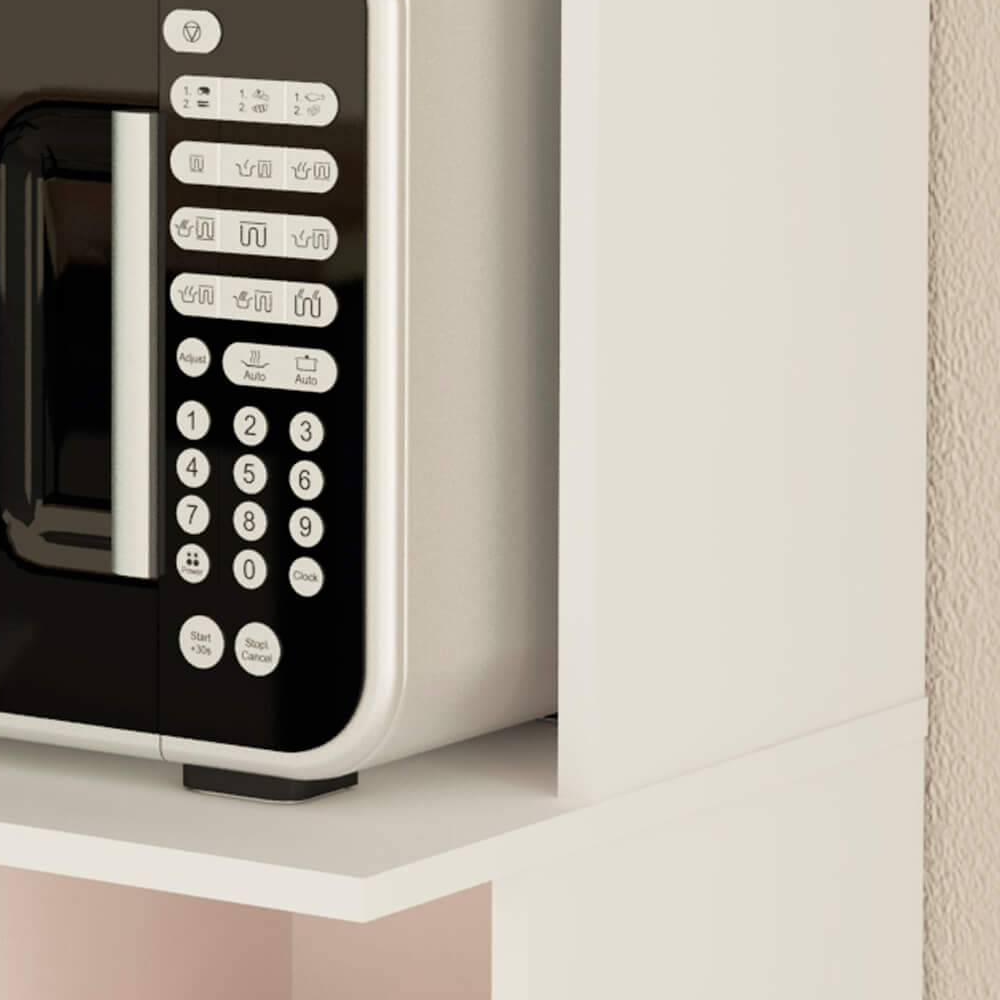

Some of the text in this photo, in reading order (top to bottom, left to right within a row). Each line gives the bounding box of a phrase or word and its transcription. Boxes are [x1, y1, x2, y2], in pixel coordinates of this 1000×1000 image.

[179, 352, 207, 365] Adjust
[243, 370, 267, 382] Auto
[295, 374, 319, 386] Auto
[187, 410, 196, 430] 1
[244, 414, 256, 436] 2
[300, 420, 312, 442] 3
[186, 457, 198, 477] 4
[243, 463, 255, 484] 5
[298, 469, 311, 490] 6
[187, 504, 198, 525] 7
[243, 510, 255, 532] 8
[300, 516, 312, 537] 9
[243, 558, 255, 580] 0
[293, 570, 318, 582] Clock
[190, 631, 212, 643] Start
[241, 649, 273, 663] Cancel
